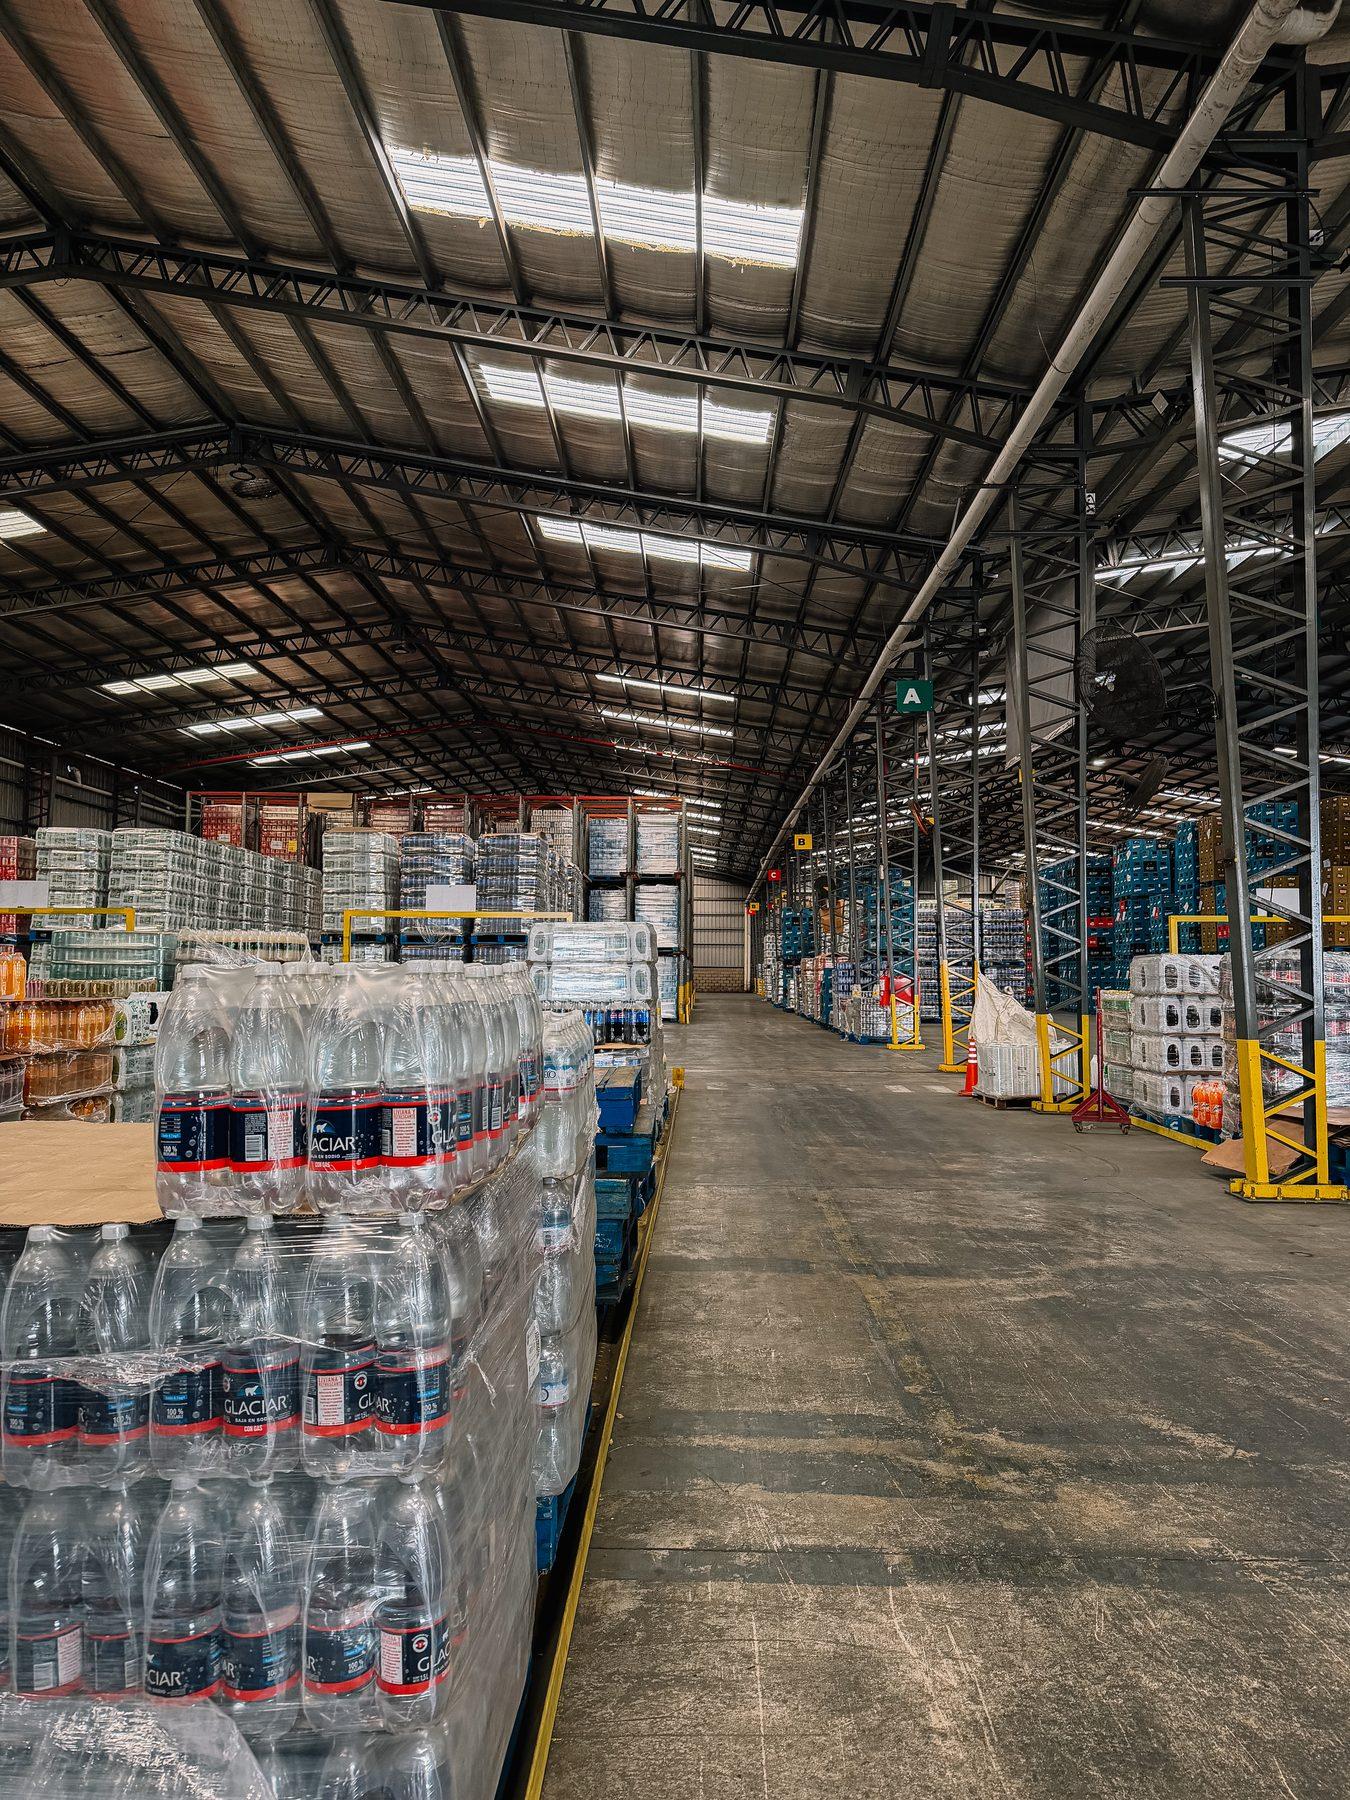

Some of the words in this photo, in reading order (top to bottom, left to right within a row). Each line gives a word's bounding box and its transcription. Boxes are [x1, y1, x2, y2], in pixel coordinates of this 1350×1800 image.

[903, 687, 921, 704] A
[798, 838, 806, 846] B
[311, 1136, 356, 1151] ACIAR
[225, 1396, 287, 1415] GLACIAR
[148, 1669, 182, 1686] CIAR
